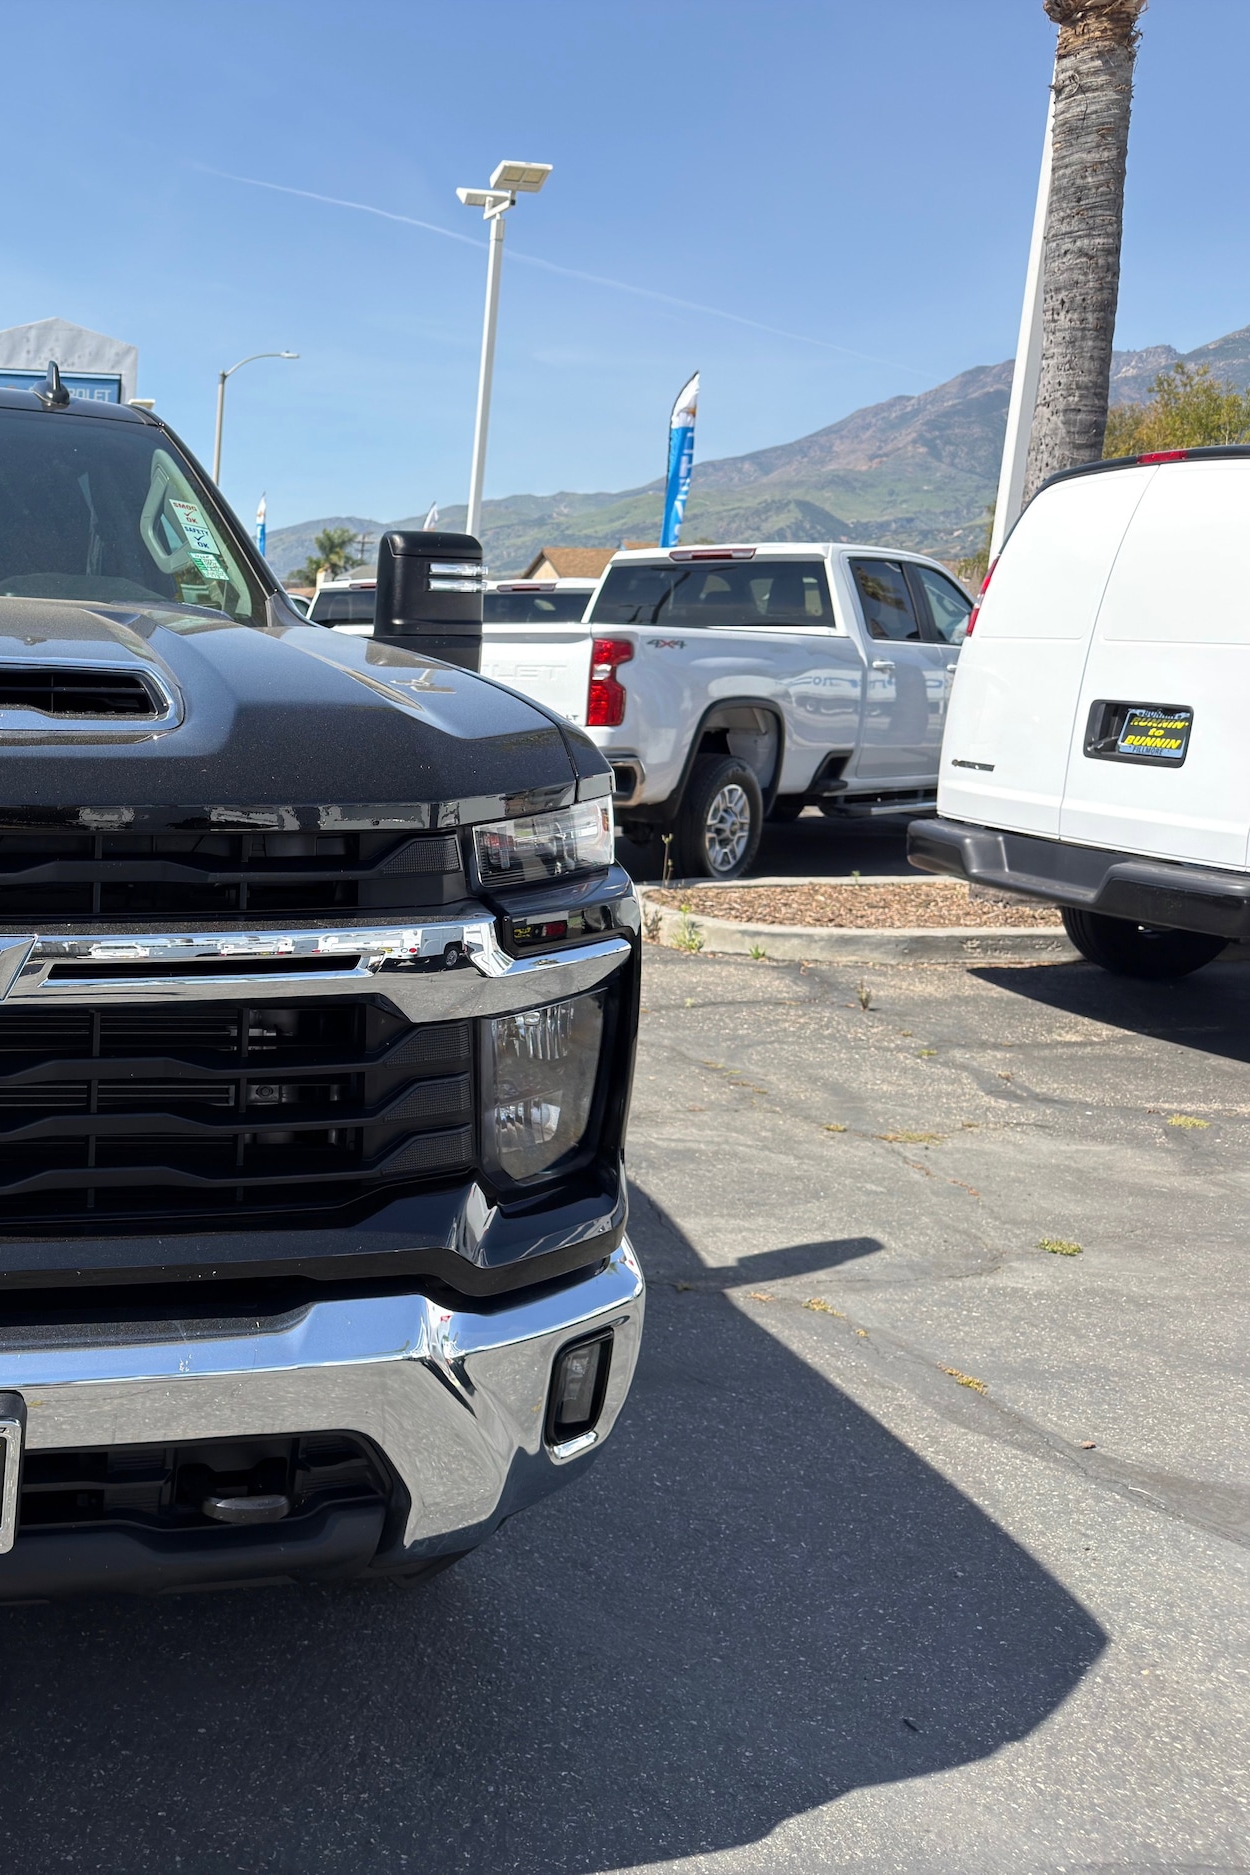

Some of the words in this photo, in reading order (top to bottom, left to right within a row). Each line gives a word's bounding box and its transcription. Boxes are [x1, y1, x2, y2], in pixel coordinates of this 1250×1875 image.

[172, 502, 198, 512] SMOG
[183, 525, 209, 536] SAFETY
[197, 541, 210, 549] OK
[1148, 728, 1165, 737] to
[1124, 735, 1182, 749] BUNNIN
[1132, 746, 1164, 756] FILLMORE
